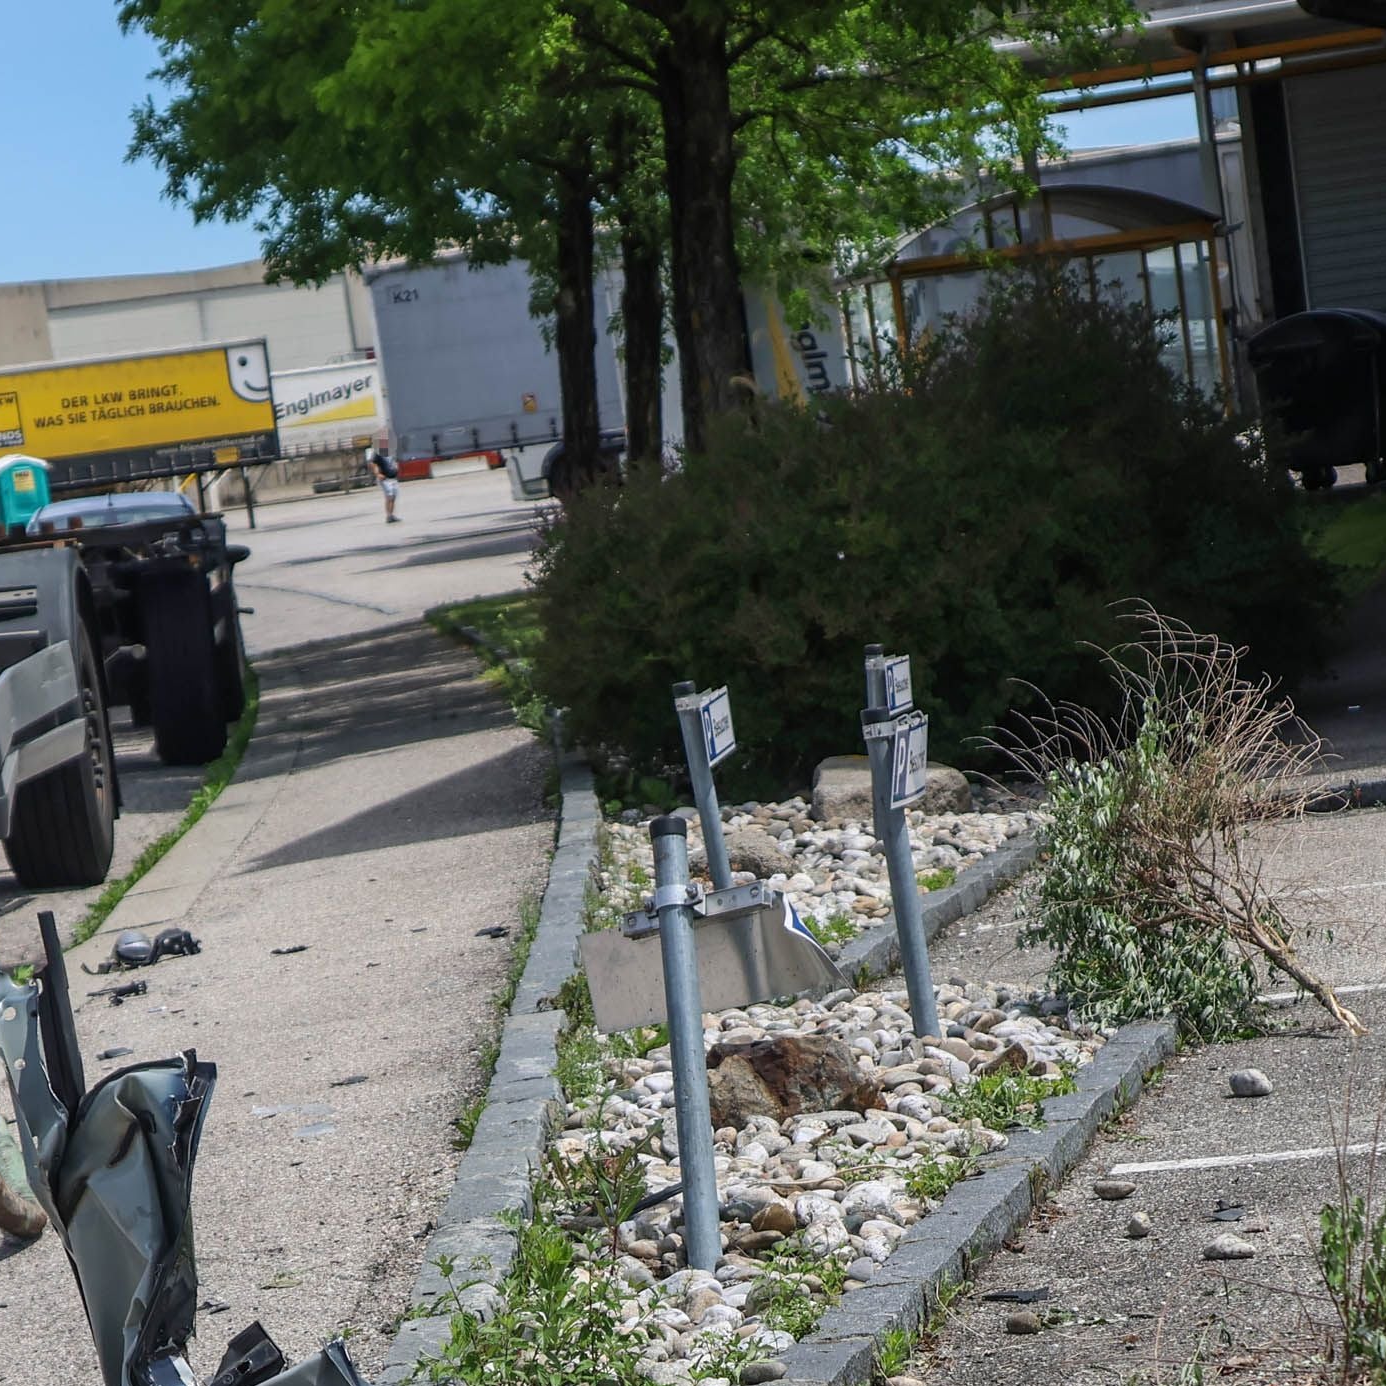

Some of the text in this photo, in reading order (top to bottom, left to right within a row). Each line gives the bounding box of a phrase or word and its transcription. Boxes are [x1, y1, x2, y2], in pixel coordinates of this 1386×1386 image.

[392, 288, 419, 304] K21
[33, 396, 220, 429] WAS SIE TÄGLICH BRAUCHEN.
[61, 395, 88, 409] DER
[94, 391, 123, 405] LKW
[275, 375, 373, 421] Englmayer
[895, 737, 906, 794] P
